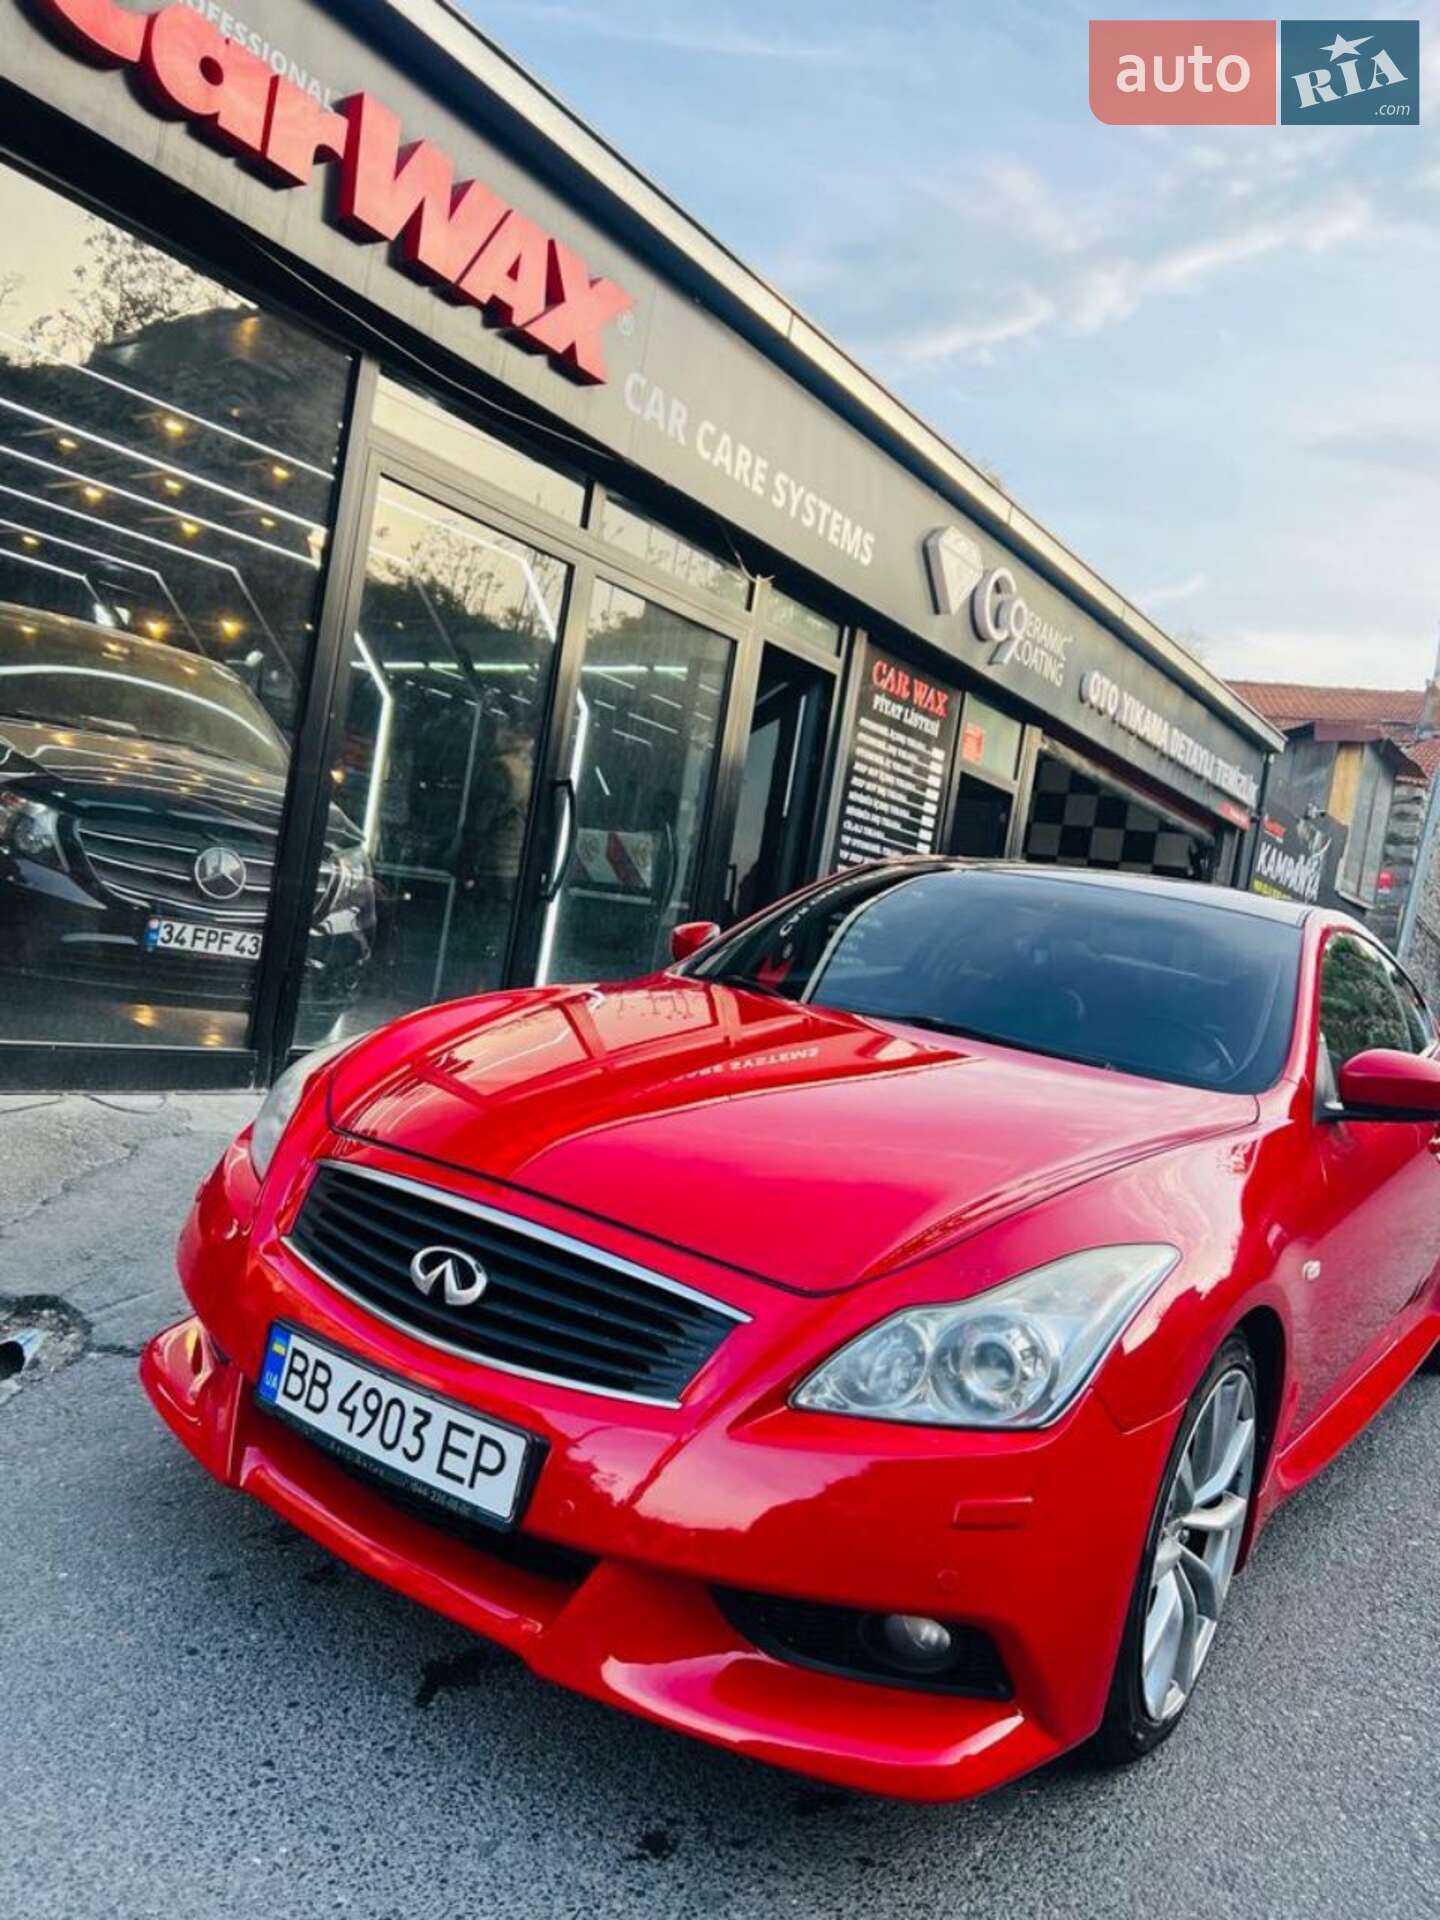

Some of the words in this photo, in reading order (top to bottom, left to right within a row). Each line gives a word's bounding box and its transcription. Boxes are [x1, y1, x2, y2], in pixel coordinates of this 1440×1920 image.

[624, 372, 687, 446] CAR
[696, 420, 767, 496] CARE
[771, 471, 874, 566] SYSTEMS
[872, 660, 910, 699] CAR
[913, 677, 949, 719] WAX
[1086, 671, 1119, 716] OTO
[161, 923, 187, 946] 34
[190, 927, 233, 952] FPF
[281, 1347, 333, 1415] BB
[337, 1379, 433, 1463] 4903
[436, 1420, 507, 1490] EP
